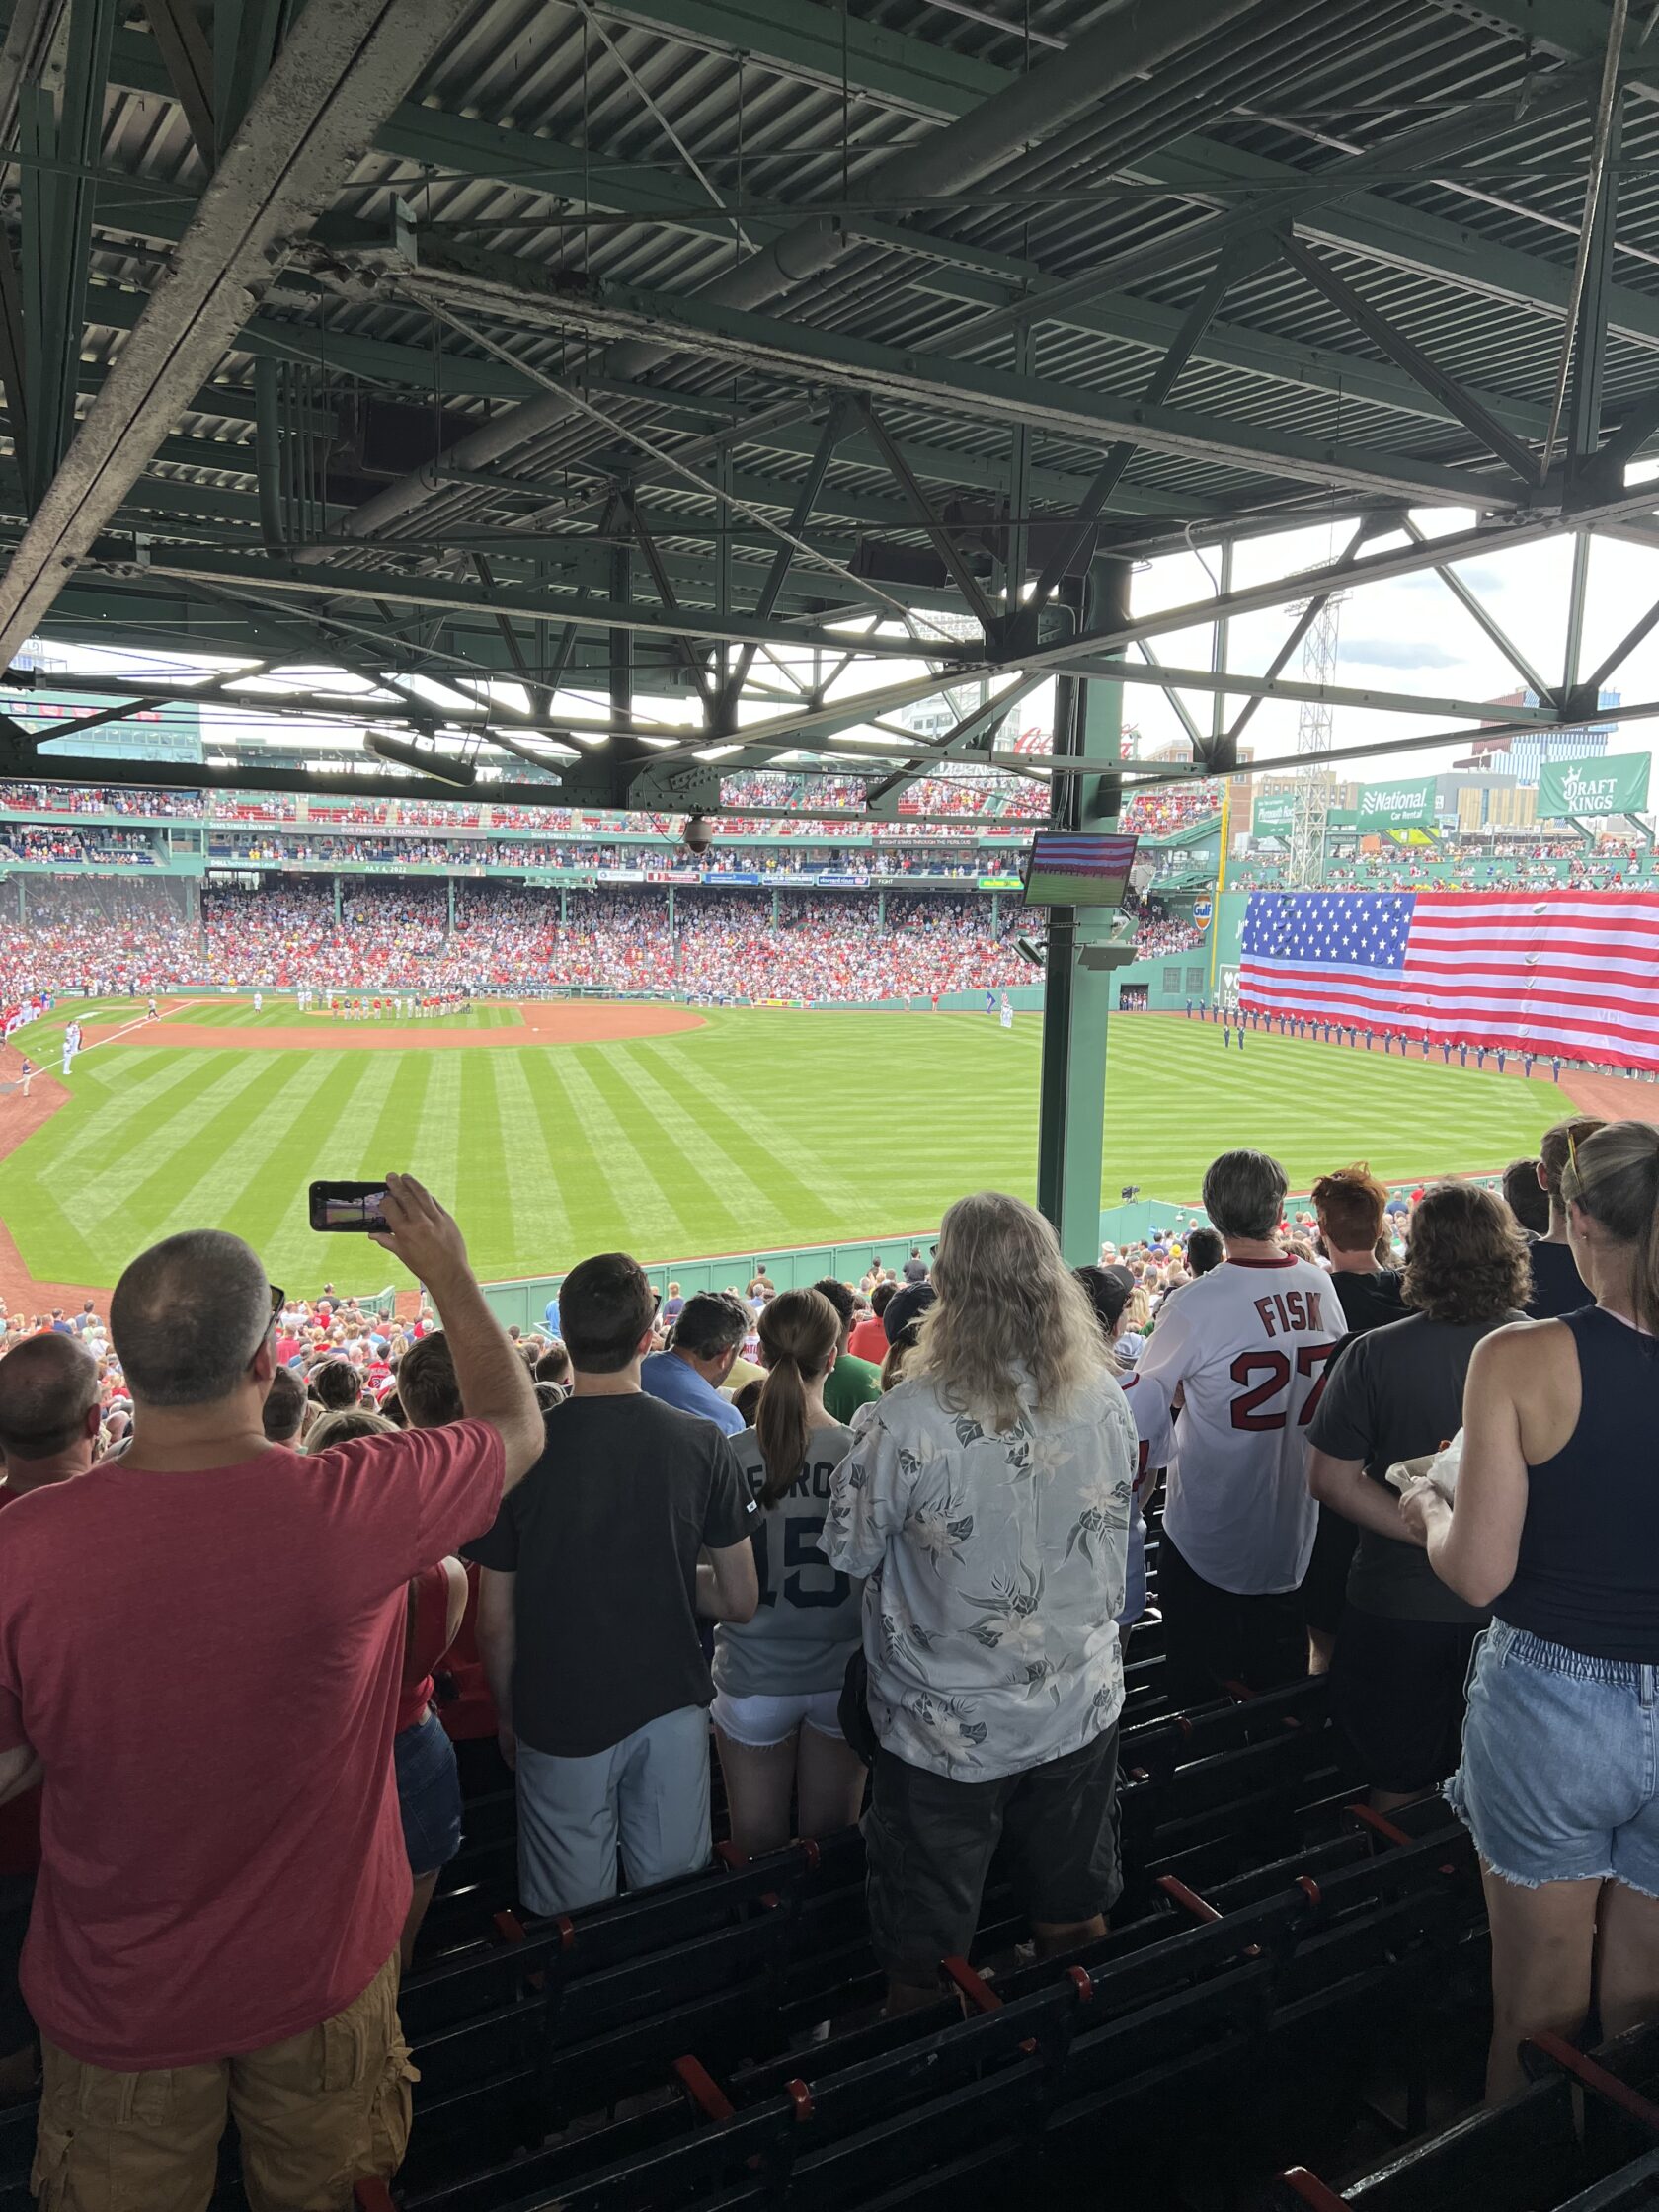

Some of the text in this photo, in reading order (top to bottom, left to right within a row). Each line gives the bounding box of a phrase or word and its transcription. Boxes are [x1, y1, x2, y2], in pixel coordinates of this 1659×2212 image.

[1563, 778, 1618, 801] DRAFT
[1390, 809, 1423, 821] Car Rental
[1568, 795, 1614, 812] KINGS
[1194, 904, 1211, 916] Gulf
[1253, 1291, 1324, 1337] FISK
[1230, 1341, 1338, 1432] 27
[751, 1516, 851, 1609] 15
